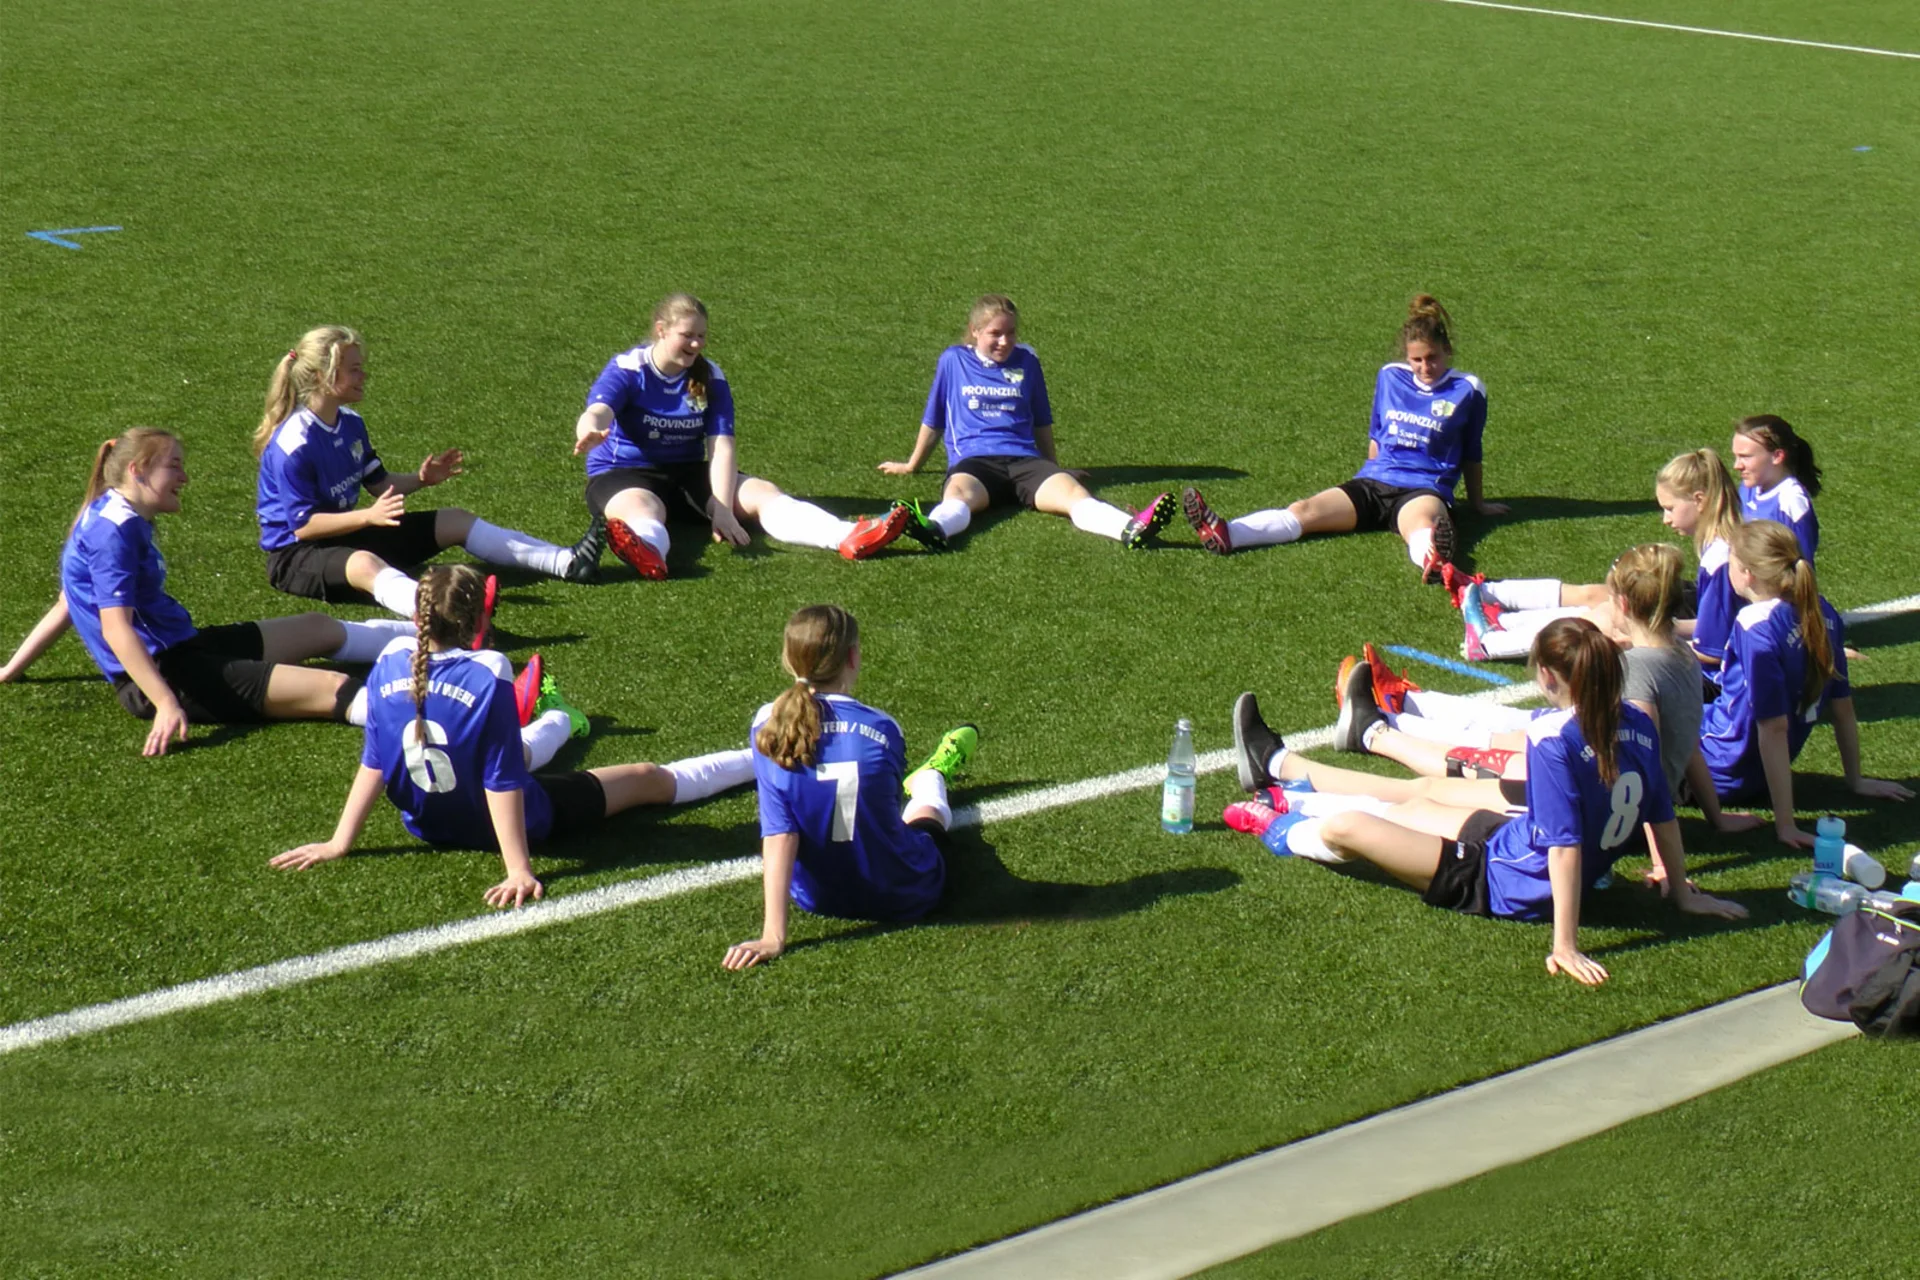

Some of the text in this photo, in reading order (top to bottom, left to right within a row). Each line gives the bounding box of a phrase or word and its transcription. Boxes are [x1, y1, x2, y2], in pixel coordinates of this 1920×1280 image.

[961, 384, 1023, 398] PROVINZIAL
[1385, 409, 1443, 433] PROVINZIAL
[402, 719, 457, 793] 6
[816, 761, 859, 842] 7
[1600, 771, 1643, 850] 8
